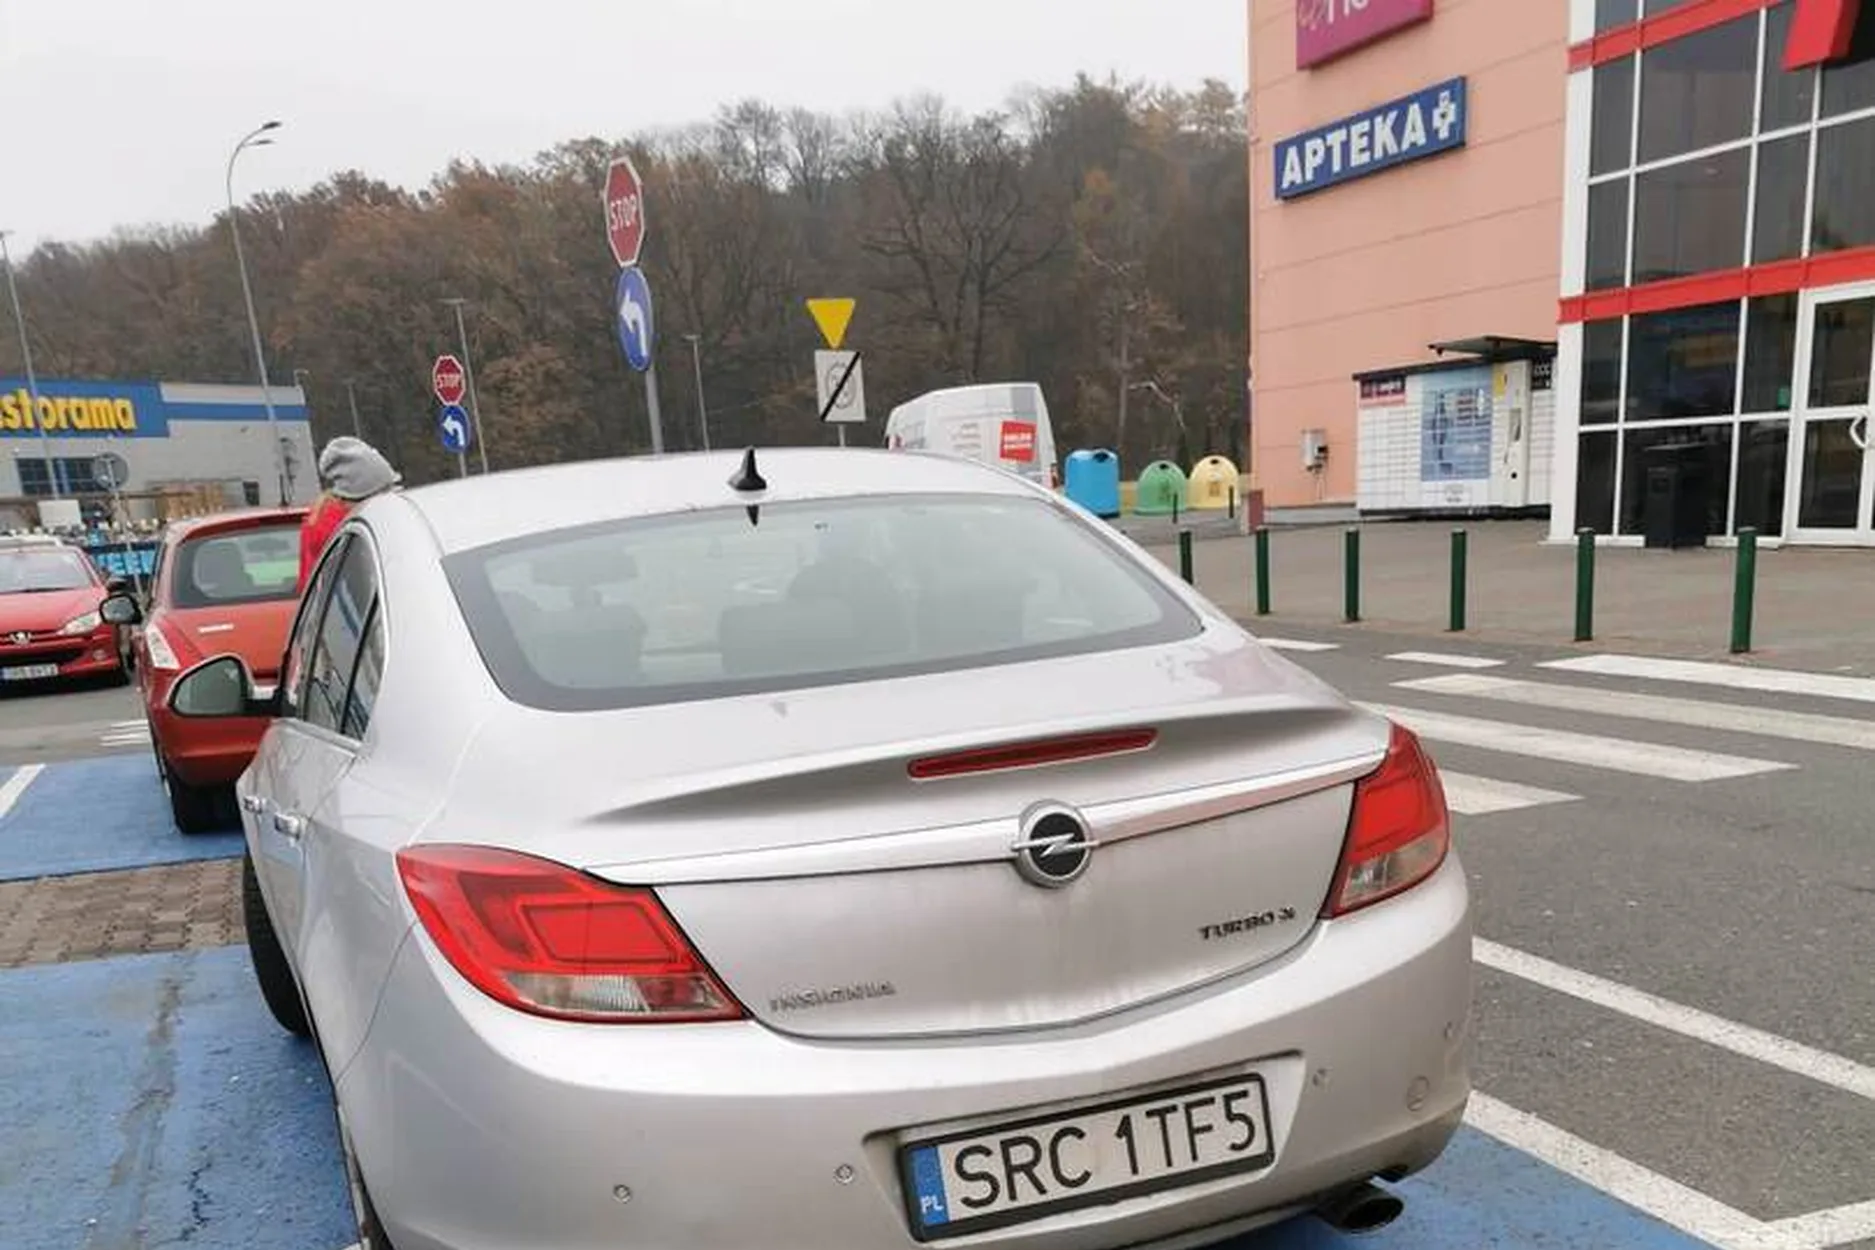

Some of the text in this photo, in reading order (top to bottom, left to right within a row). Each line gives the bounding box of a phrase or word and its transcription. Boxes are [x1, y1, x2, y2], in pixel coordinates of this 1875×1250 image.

[1281, 102, 1427, 189] APTEKA
[610, 193, 637, 231] STOP
[437, 373, 462, 389] STOP
[0, 387, 137, 430] storama
[1198, 911, 1275, 940] TURBO
[954, 1090, 1257, 1209] SRC 1TF5
[919, 1194, 944, 1214] PL
